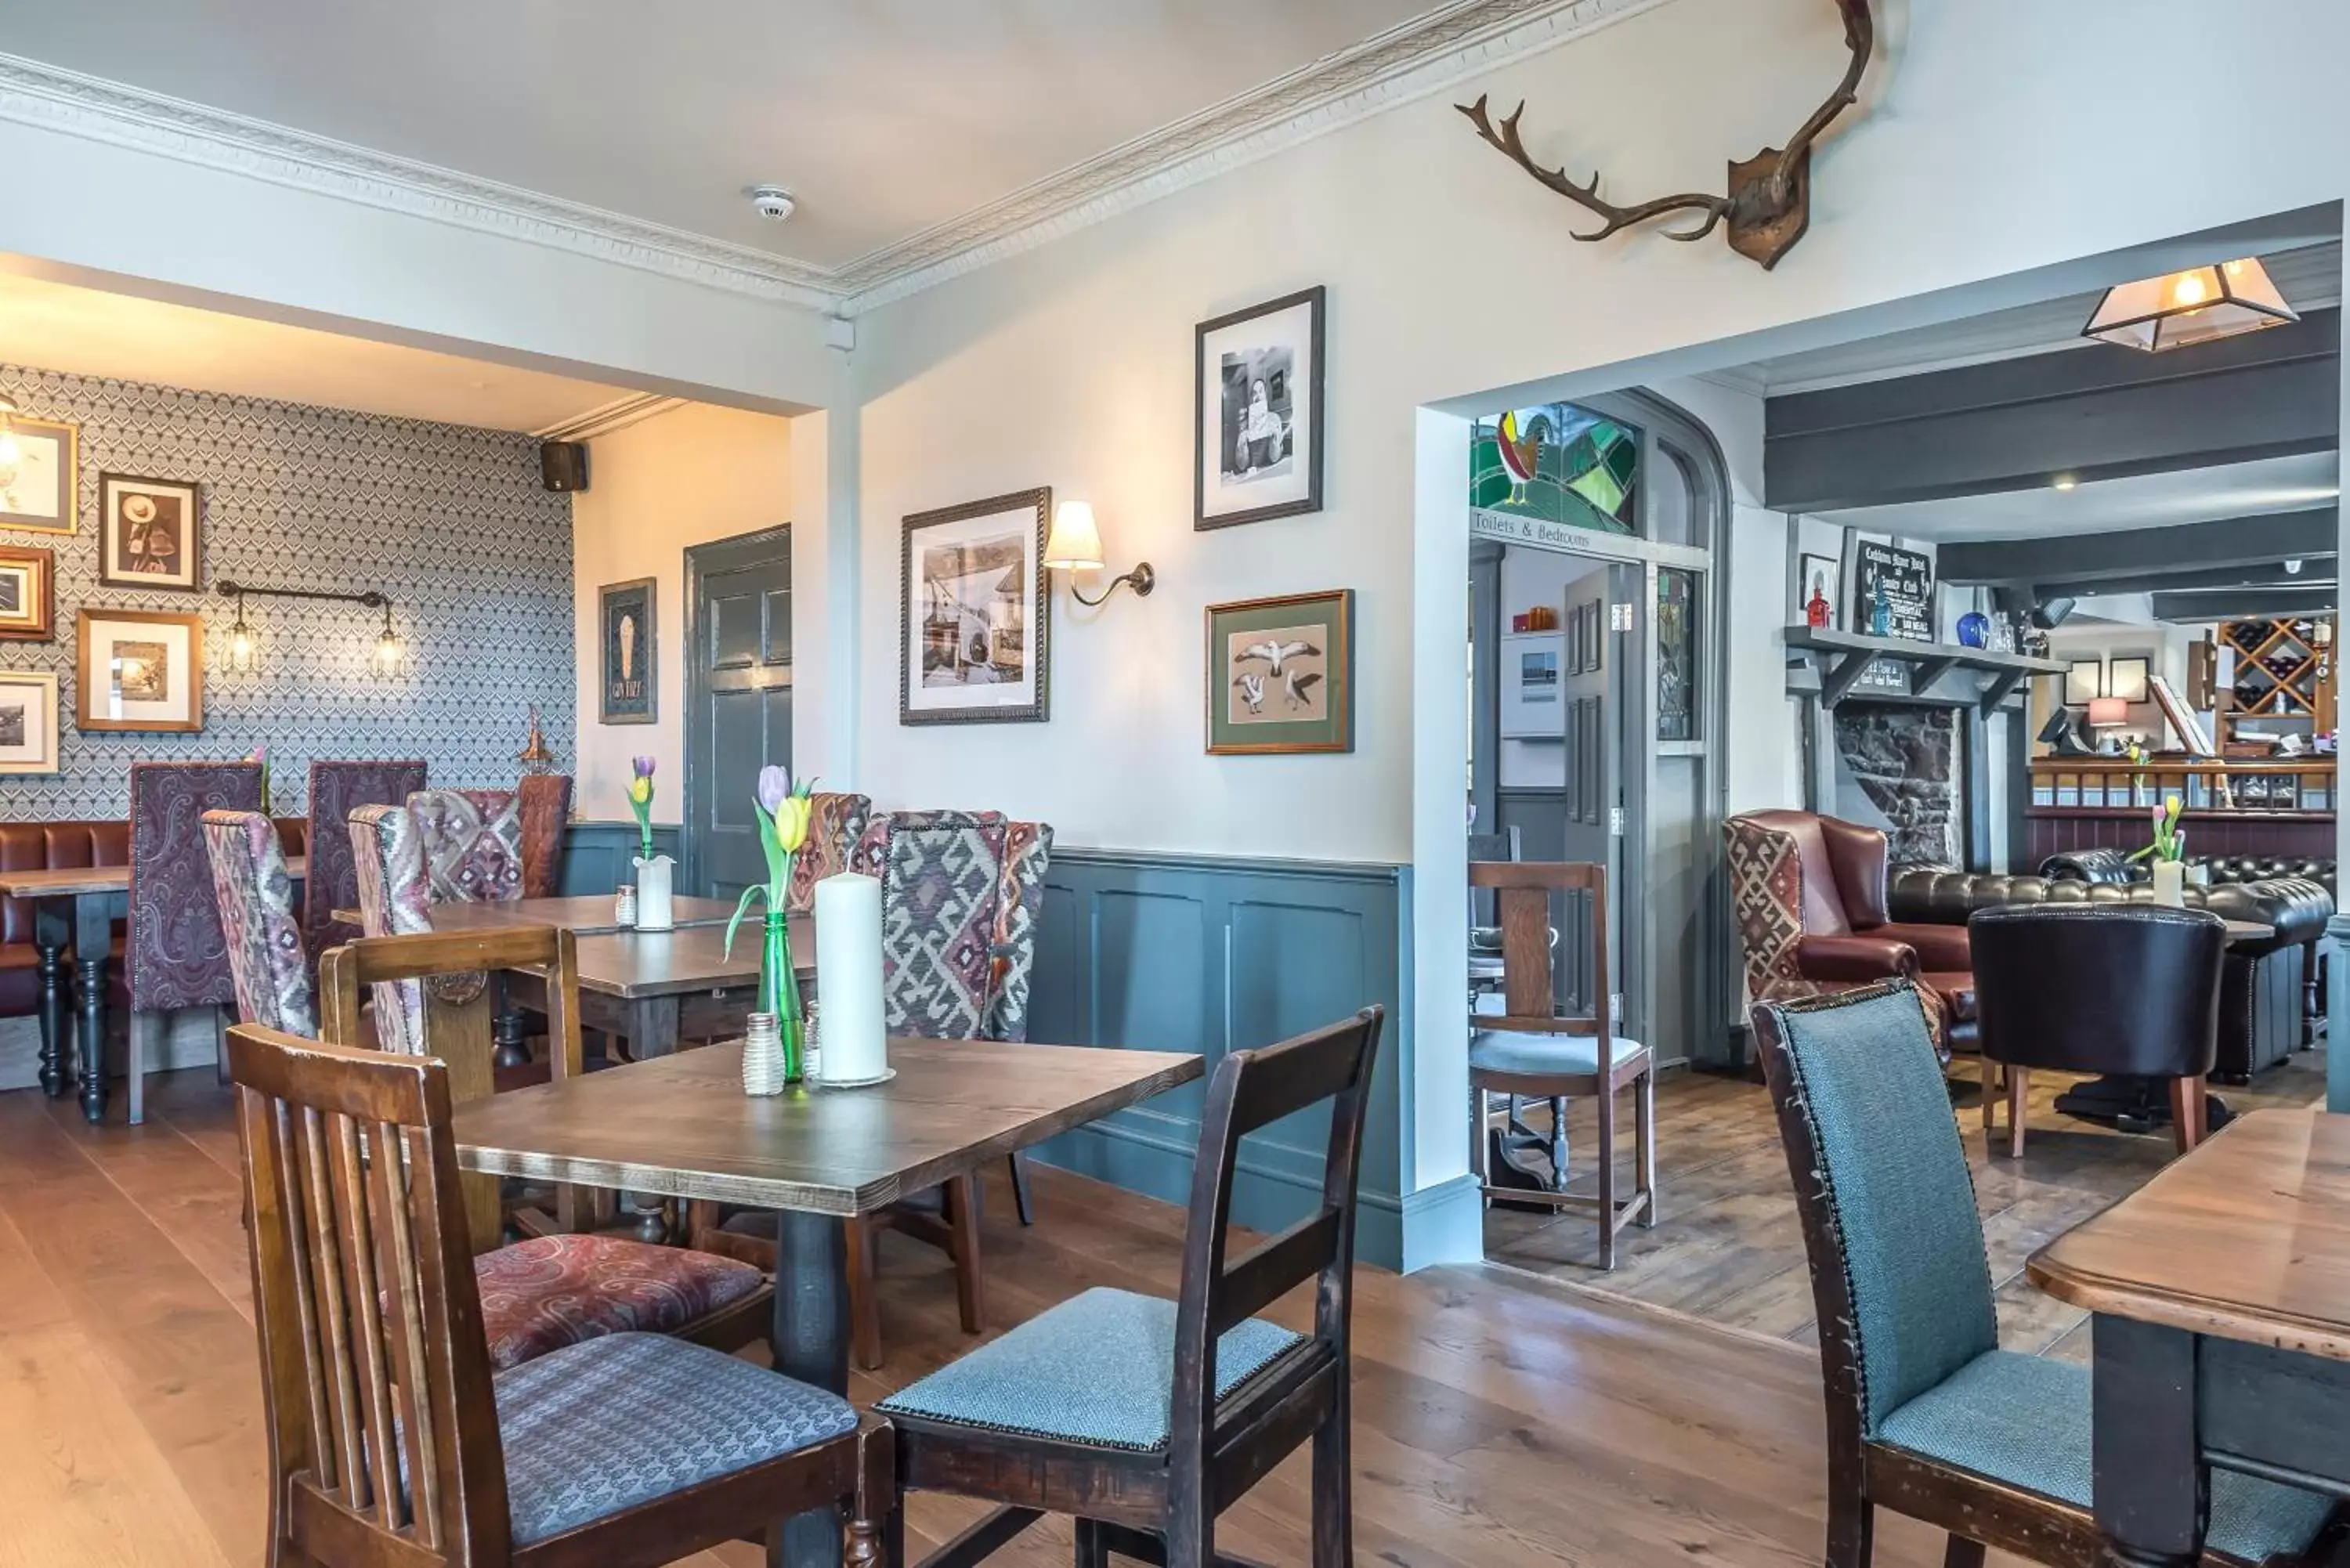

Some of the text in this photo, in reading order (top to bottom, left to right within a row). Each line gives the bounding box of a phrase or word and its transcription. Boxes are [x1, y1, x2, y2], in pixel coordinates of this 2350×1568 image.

[1475, 512, 1590, 547] Toilets & Bedrooms
